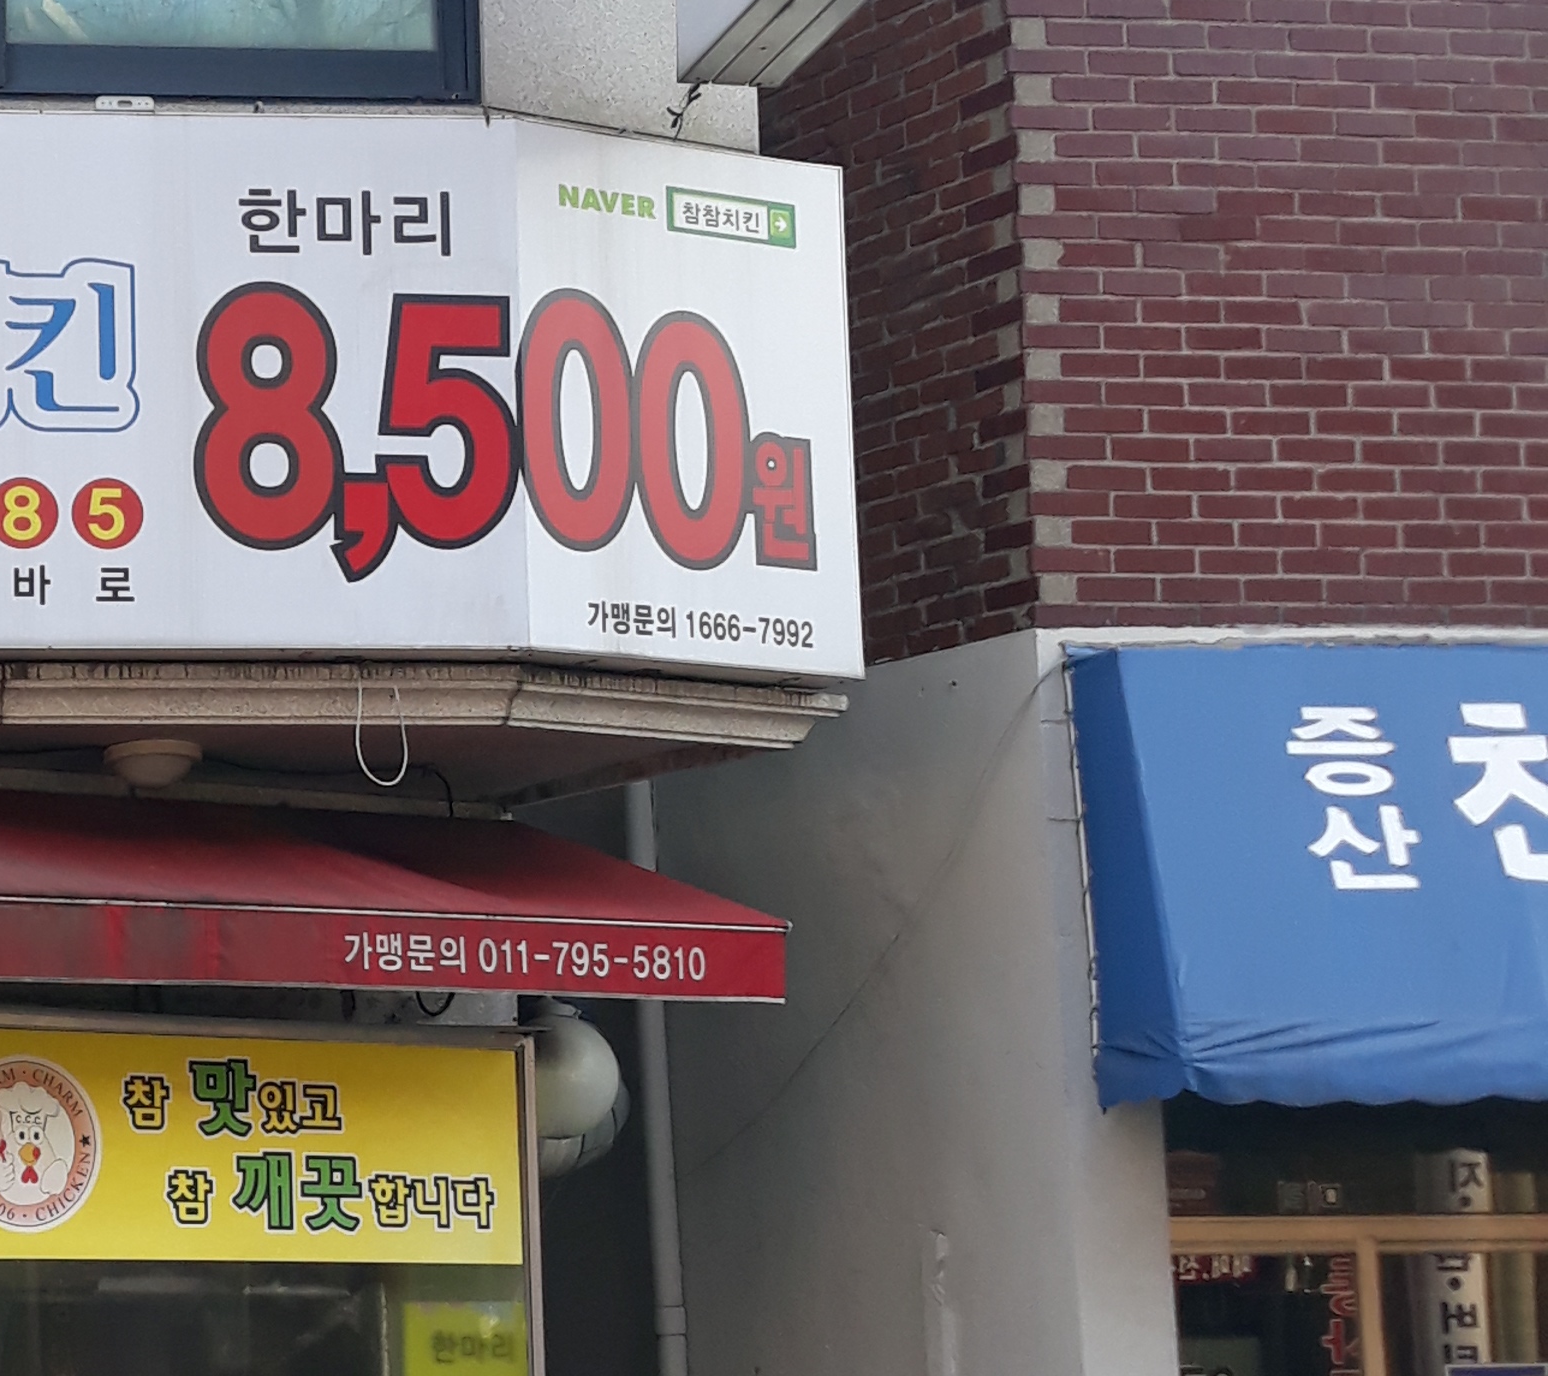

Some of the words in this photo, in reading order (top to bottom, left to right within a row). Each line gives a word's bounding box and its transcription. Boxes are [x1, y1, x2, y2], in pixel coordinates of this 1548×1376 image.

[238, 187, 453, 257] 한마리
[557, 183, 657, 221] NAVER
[680, 199, 763, 235] 참참치킨
[193, 280, 819, 584] 8,500원
[586, 599, 678, 640] 가맹문의
[684, 607, 815, 650] 1666-7992
[342, 931, 468, 975] 가맹문의
[478, 938, 708, 983] 011-795-5810
[123, 1076, 170, 1132] 참
[189, 1058, 342, 1137] 맛있고
[168, 1170, 213, 1226] 참
[233, 1152, 494, 1232] 깨끗합니다
